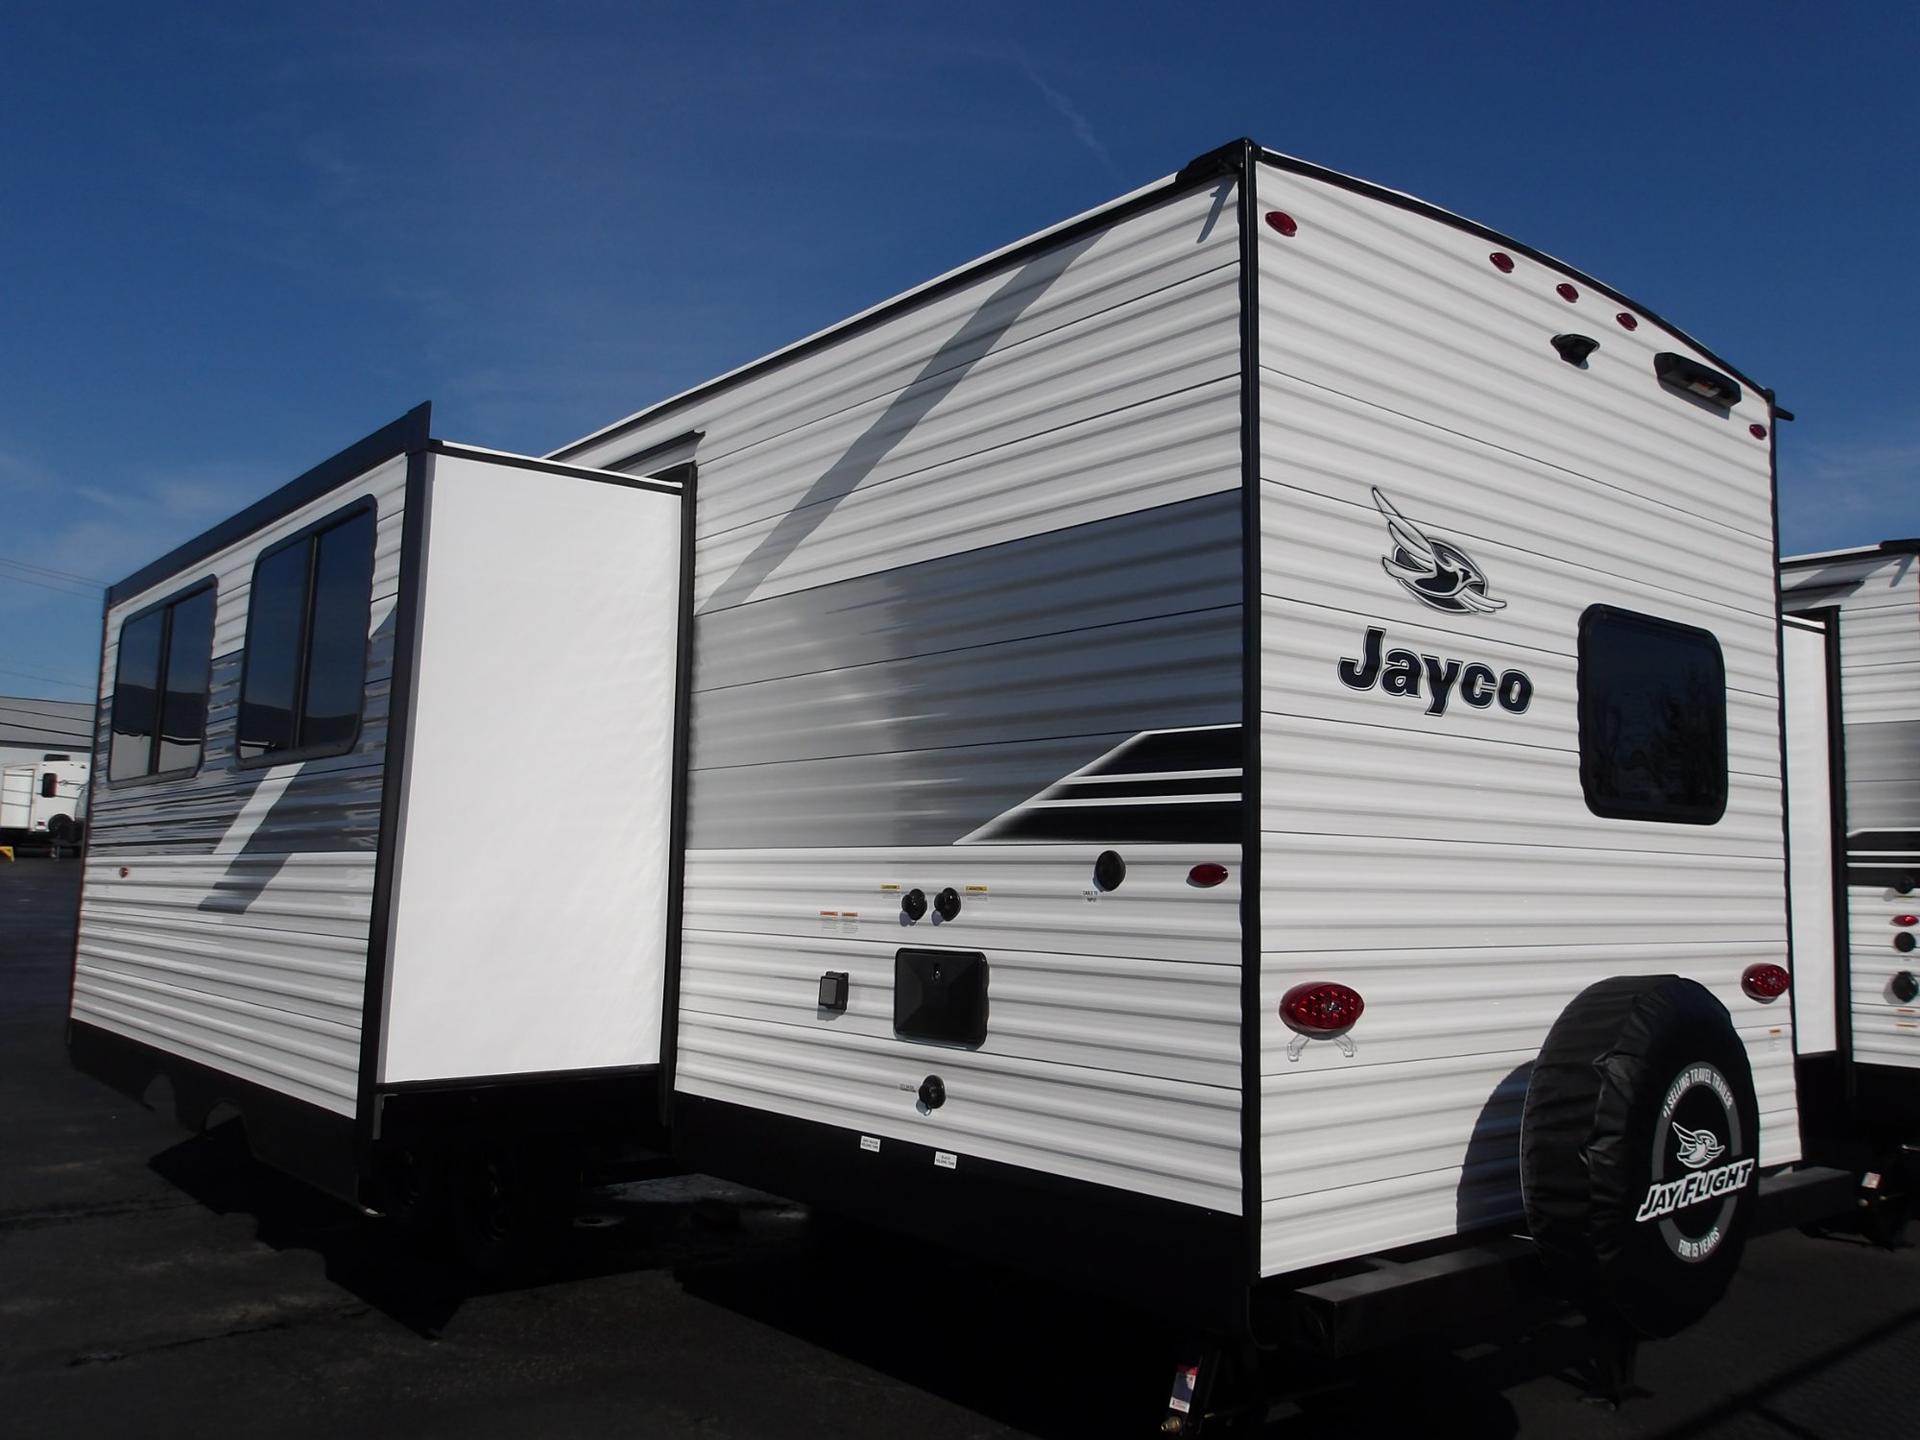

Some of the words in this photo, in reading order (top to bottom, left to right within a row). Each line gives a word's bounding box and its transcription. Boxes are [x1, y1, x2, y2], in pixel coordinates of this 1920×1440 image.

[1337, 625, 1534, 716] Jayco
[1667, 1072, 1690, 1109] SELLING
[1690, 1067, 1711, 1084] TRAVEL
[1712, 1072, 1733, 1110] TRAILER
[1678, 1239, 1691, 1257] FOR
[1699, 1226, 1720, 1255] YEARS
